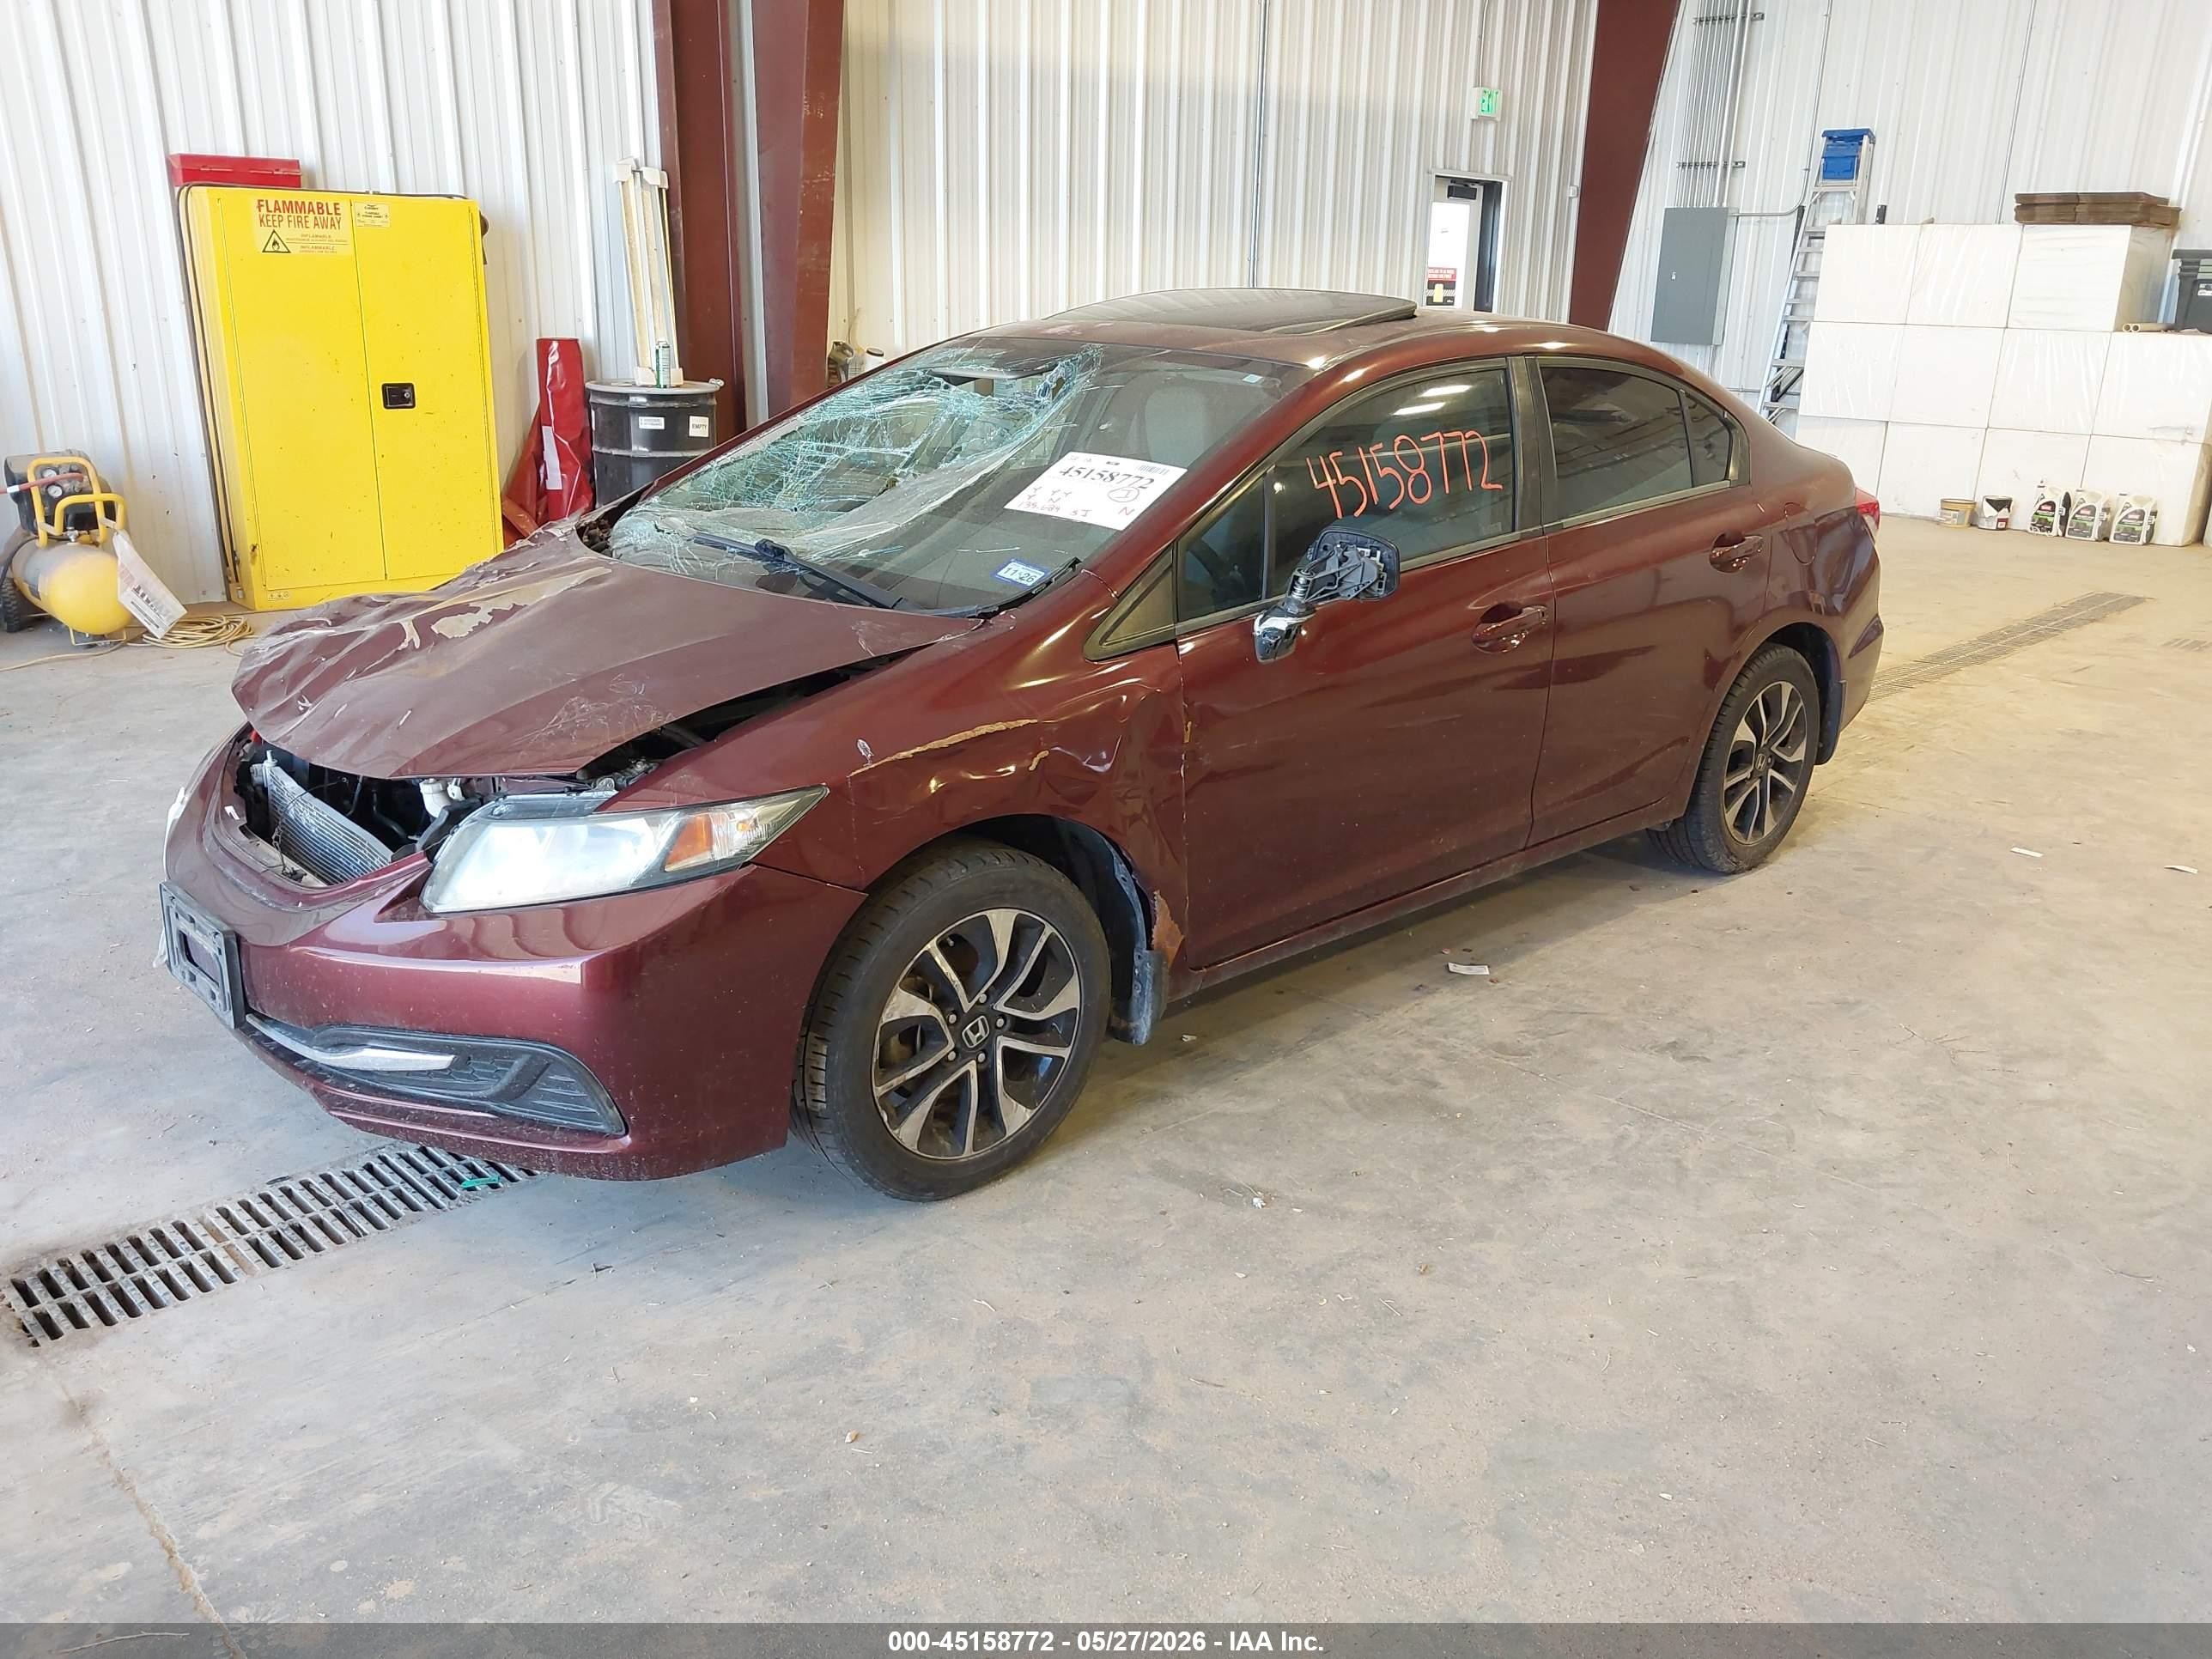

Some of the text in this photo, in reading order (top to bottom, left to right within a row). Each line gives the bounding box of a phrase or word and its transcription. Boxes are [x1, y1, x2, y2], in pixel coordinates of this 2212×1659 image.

[257, 199, 341, 216] FLAMMABLE
[258, 214, 283, 228] KEEP
[287, 215, 310, 228] FIRE
[313, 216, 341, 229] AWAY
[1060, 466, 1154, 489] 45158772
[1305, 430, 1503, 519] 45158772
